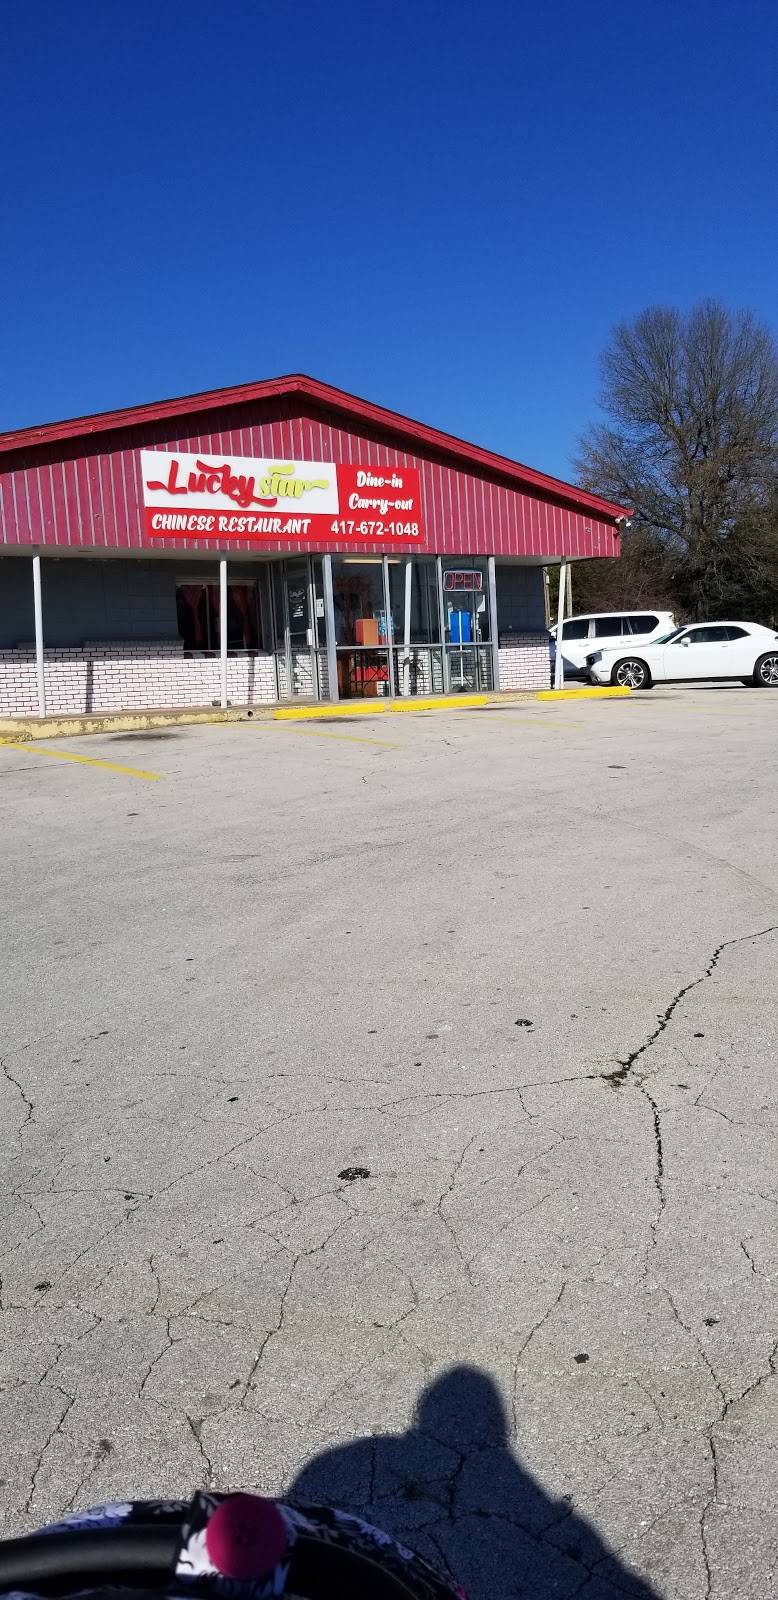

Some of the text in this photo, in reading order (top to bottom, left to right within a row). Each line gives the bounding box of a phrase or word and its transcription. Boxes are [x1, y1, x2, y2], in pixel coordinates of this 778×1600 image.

[146, 459, 329, 508] Lucky star
[356, 471, 403, 489] Dine-in
[348, 493, 414, 515] Carry-out
[151, 513, 311, 534] CHINESE RESTAURANT
[330, 520, 419, 536] 417-672-1048
[445, 572, 482, 591] OPEN
